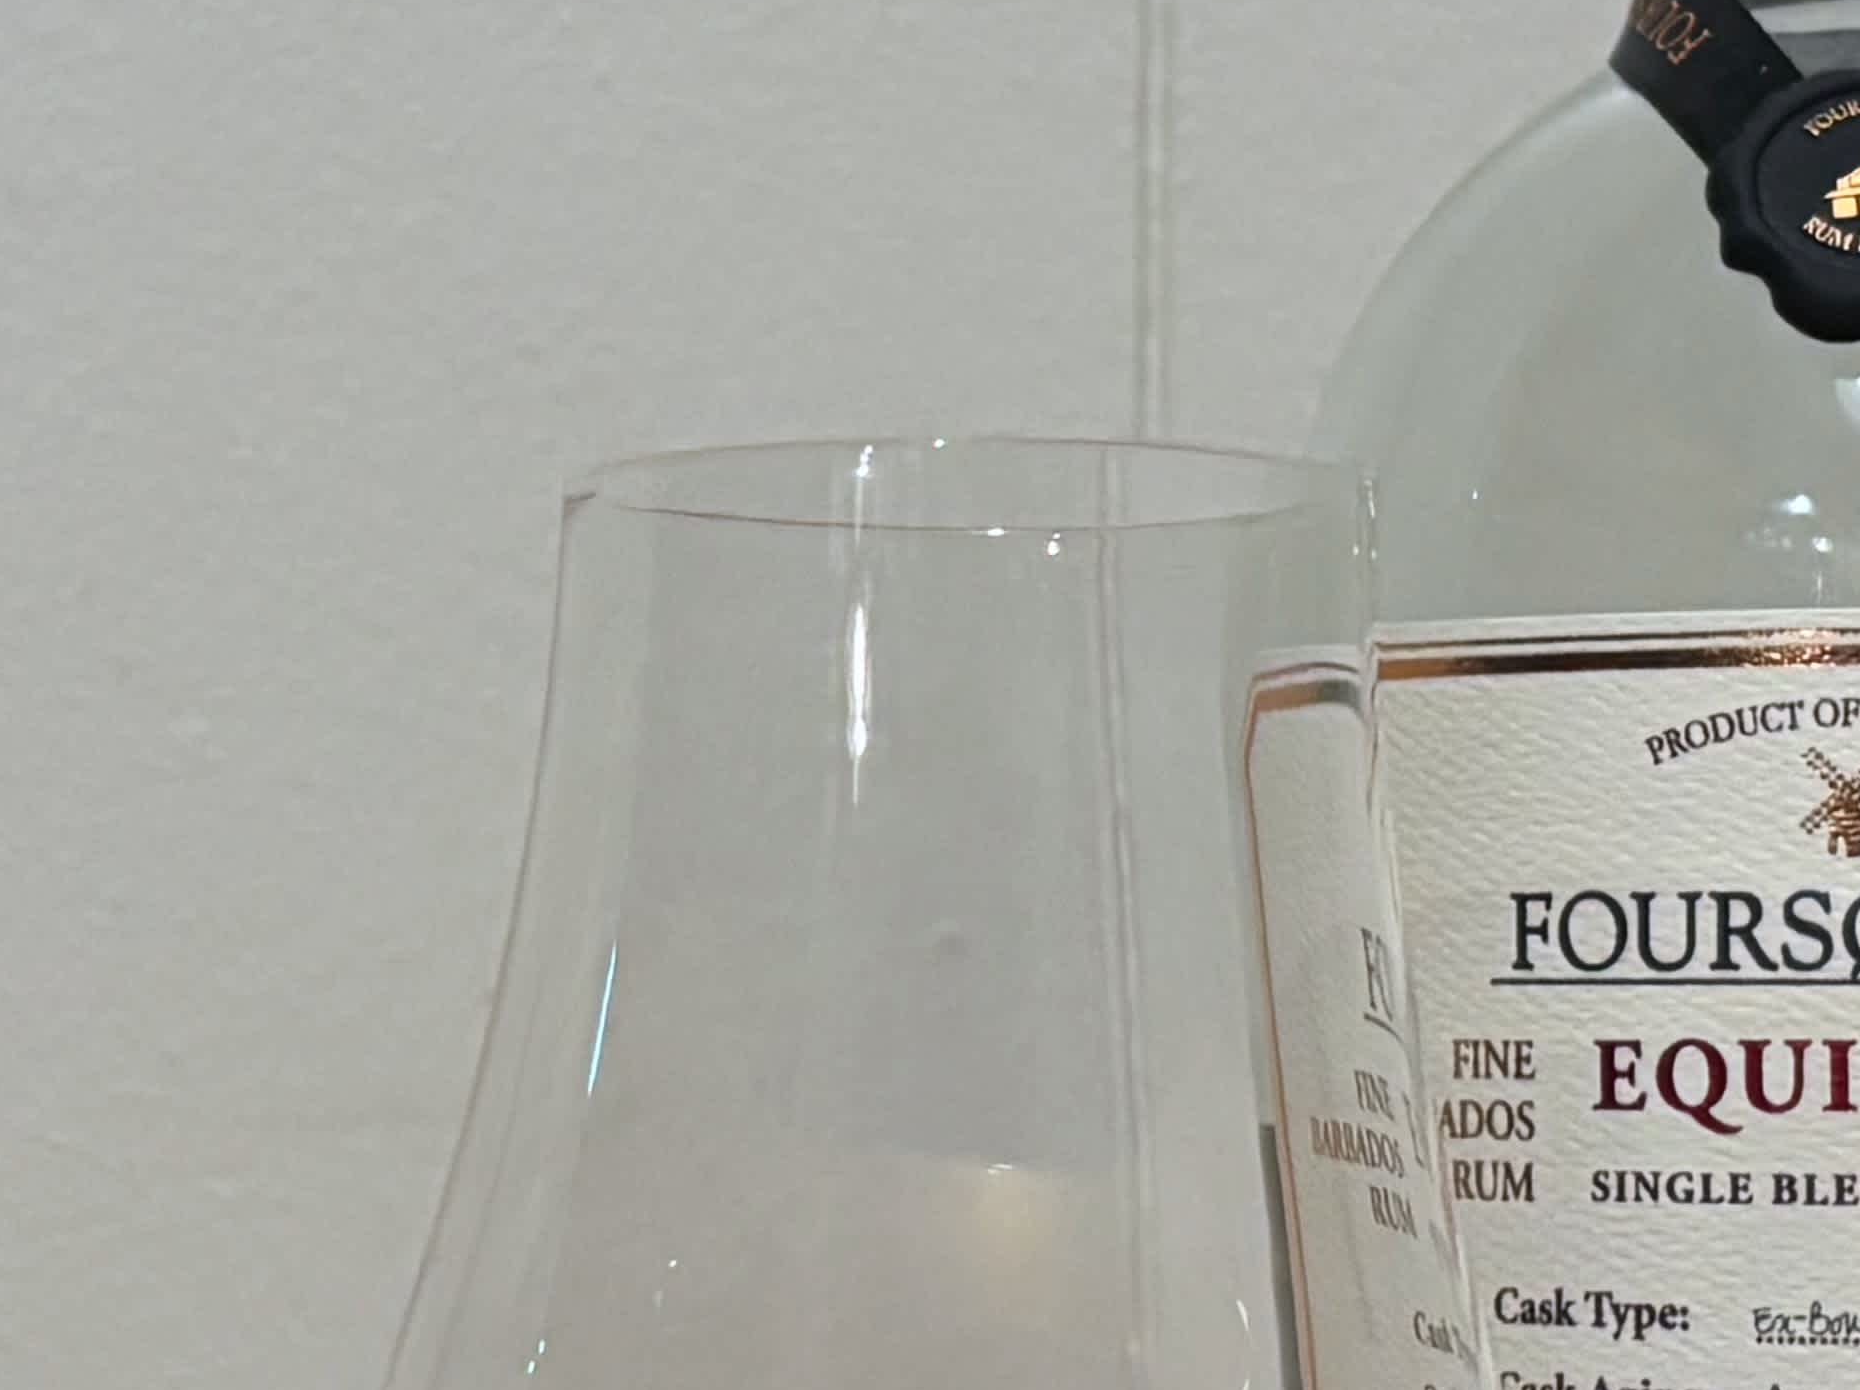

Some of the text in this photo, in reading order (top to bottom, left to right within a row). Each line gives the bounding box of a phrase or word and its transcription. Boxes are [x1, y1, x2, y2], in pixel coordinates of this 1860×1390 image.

[1802, 216, 1854, 251] RUM
[1644, 699, 1804, 766] PRODUCT
[1452, 1038, 1536, 1080] FINE
[1438, 1100, 1536, 1141] ADOS
[1452, 1159, 1535, 1202] RUM
[1590, 1170, 1753, 1205] SINGLE
[1494, 1287, 1690, 1341] Cask Type:
